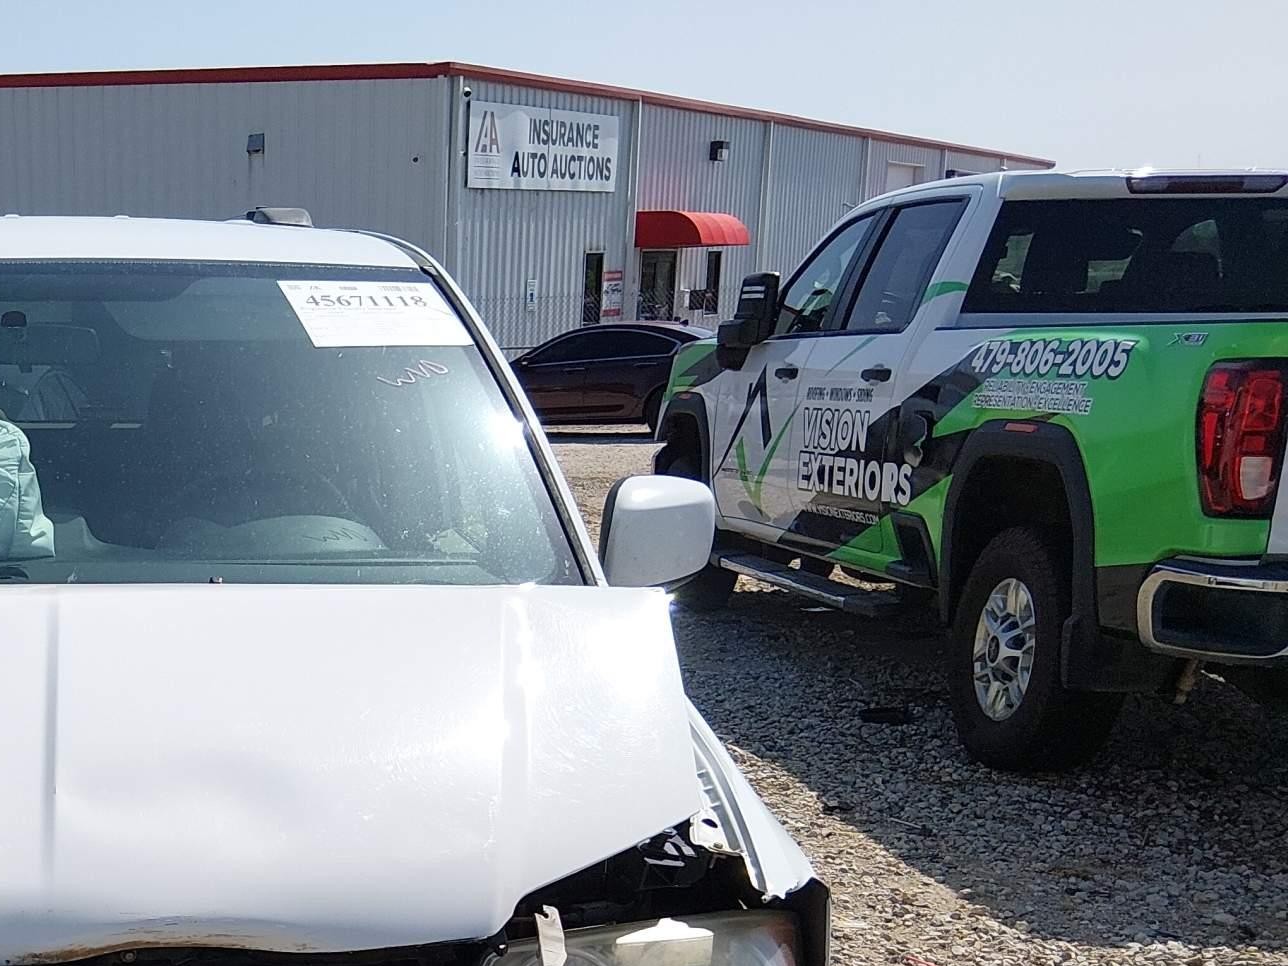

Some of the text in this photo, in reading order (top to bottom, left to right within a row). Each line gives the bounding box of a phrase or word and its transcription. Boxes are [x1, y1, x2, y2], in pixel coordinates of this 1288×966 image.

[528, 118, 600, 150] INSURANCE
[510, 151, 612, 182] AUTO AUCTIONS
[306, 294, 427, 308] 45671118
[970, 339, 1140, 379] 479-806-2005
[802, 407, 870, 452] VISION
[797, 451, 913, 506] EXTERIORS
